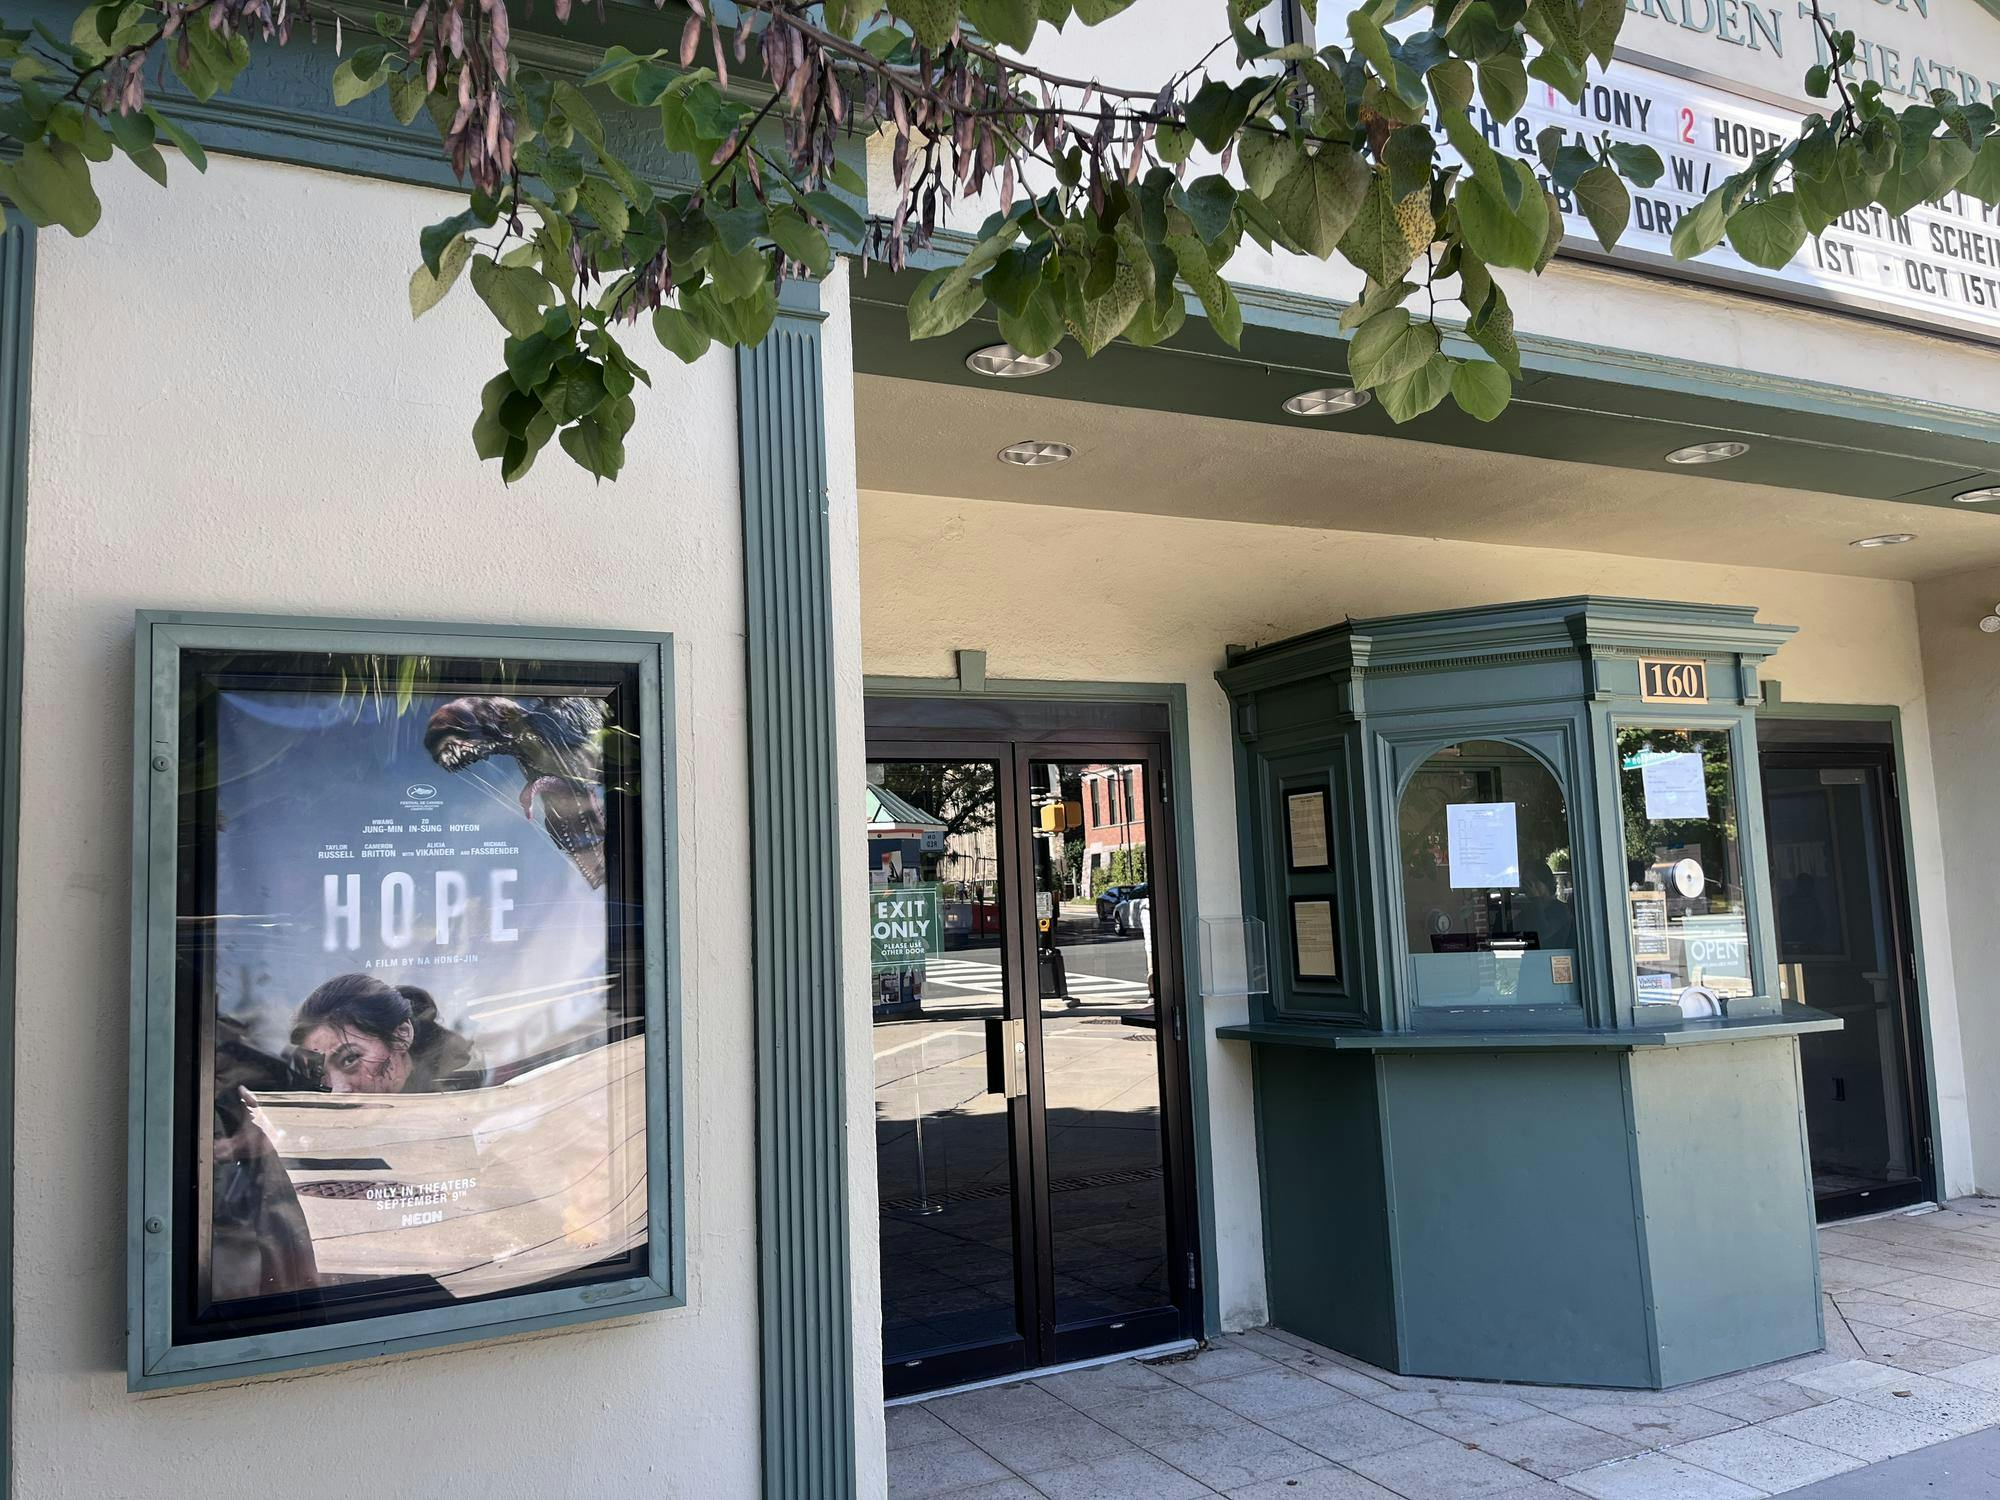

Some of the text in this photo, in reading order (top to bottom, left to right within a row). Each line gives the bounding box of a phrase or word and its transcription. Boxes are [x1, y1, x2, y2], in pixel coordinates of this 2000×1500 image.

[1681, 107, 1696, 145] 2
[1829, 205, 2000, 268] USTIN SCHEI
[1905, 259, 1948, 297] OCT
[1960, 272, 2000, 309] 15T
[1651, 664, 1698, 697] 160
[362, 824, 480, 833] JUNG-MIN IN-SUNG HOYEON
[318, 851, 355, 859] RUSSELL
[361, 850, 396, 858] BRITTON
[416, 849, 455, 857] VIKANDER
[471, 847, 519, 856] FASSBENDER
[323, 868, 519, 951] HOPE
[878, 900, 925, 919] EXIT
[873, 920, 931, 939] ONLY
[1691, 940, 1739, 961] OPEN
[365, 955, 478, 968] A FILM BY NA HONG-JIN
[366, 1177, 477, 1200] ONLY IN THEATERS
[376, 1193, 448, 1211] SEPTEMBER
[401, 1210, 443, 1227] NEON
